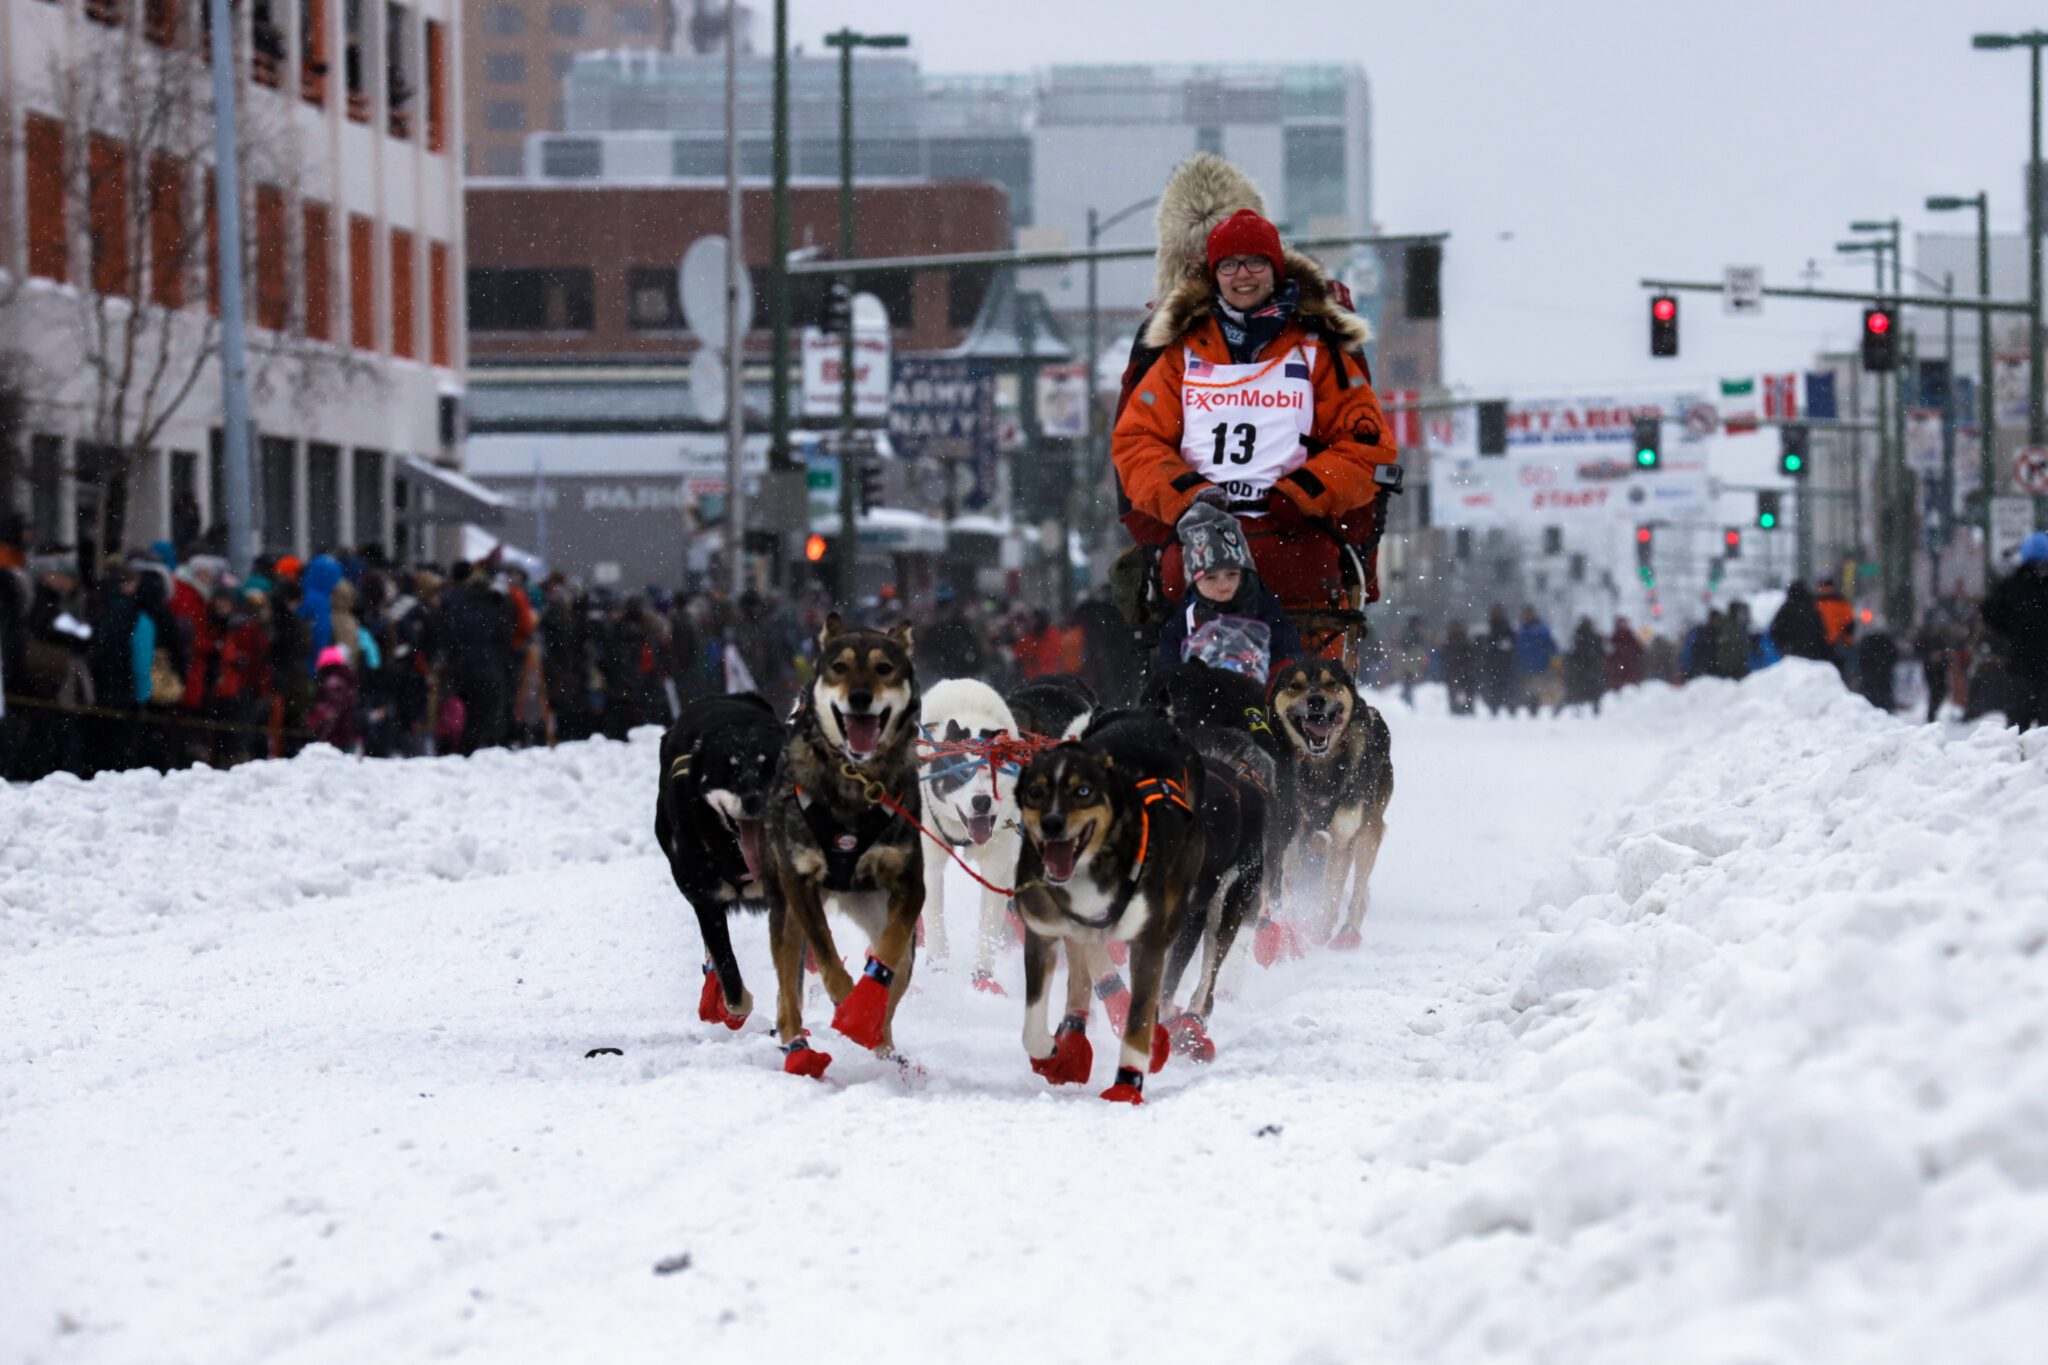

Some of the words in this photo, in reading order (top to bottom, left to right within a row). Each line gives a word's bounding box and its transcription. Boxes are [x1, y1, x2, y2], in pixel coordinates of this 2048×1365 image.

[890, 381, 975, 405] ARMY
[1185, 388, 1304, 413] ExxonMobil
[889, 412, 976, 436] NAVY
[1211, 422, 1257, 466] 13
